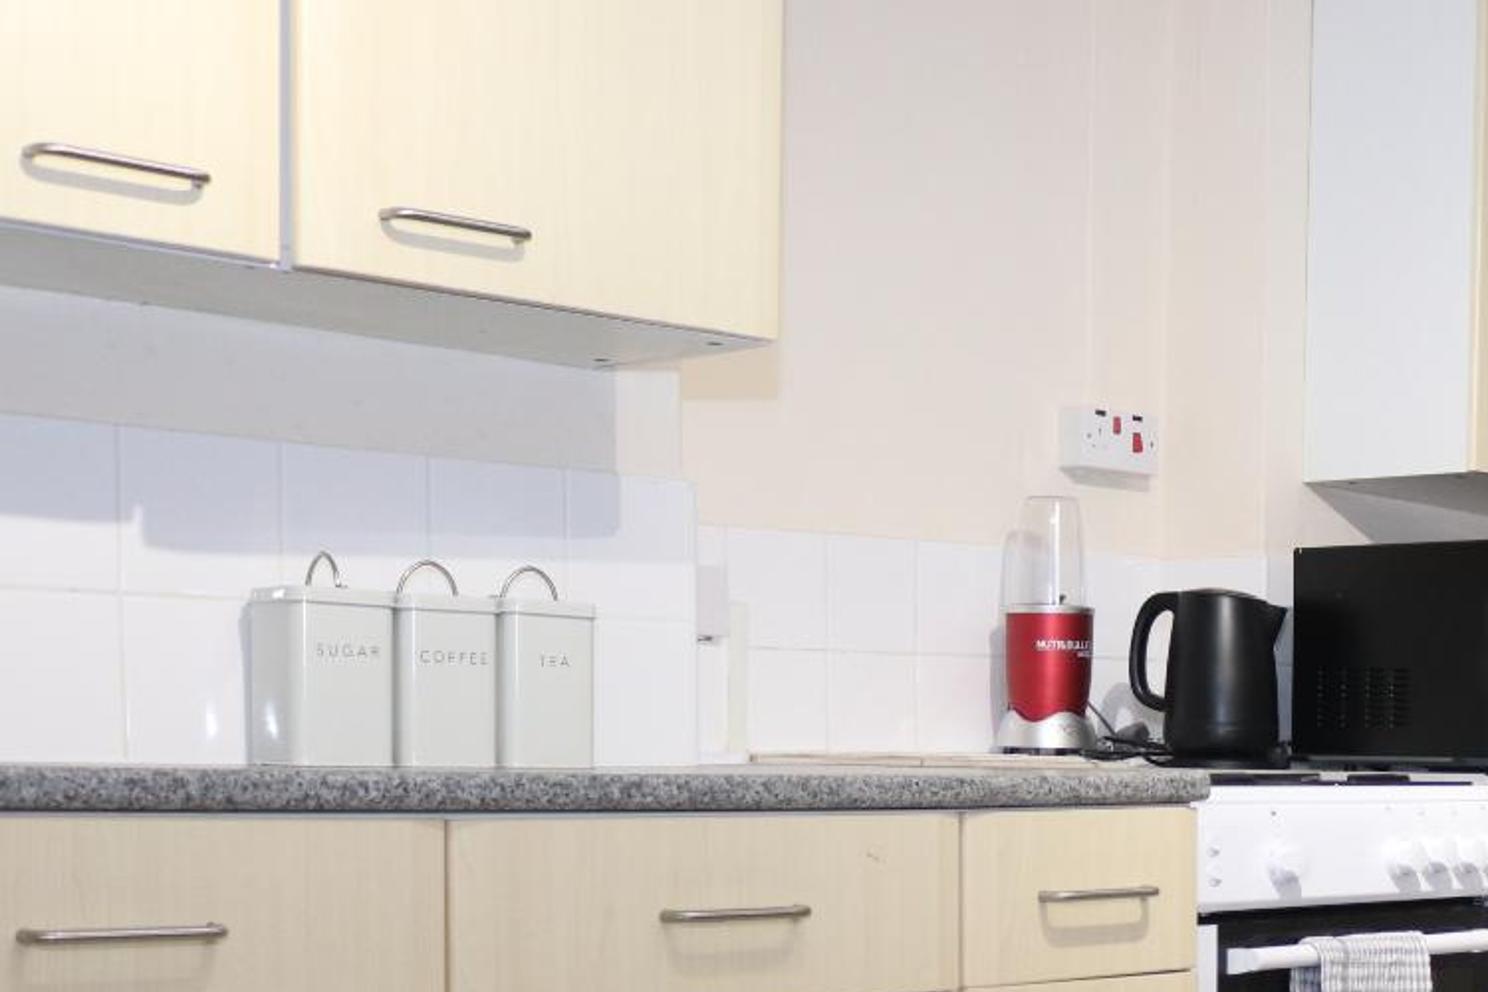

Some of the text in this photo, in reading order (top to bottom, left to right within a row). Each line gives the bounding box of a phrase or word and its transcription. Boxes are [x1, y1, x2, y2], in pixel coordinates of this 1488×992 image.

[316, 643, 380, 658] SUGAR
[420, 650, 488, 666] COFFEE
[540, 655, 570, 668] TEA
